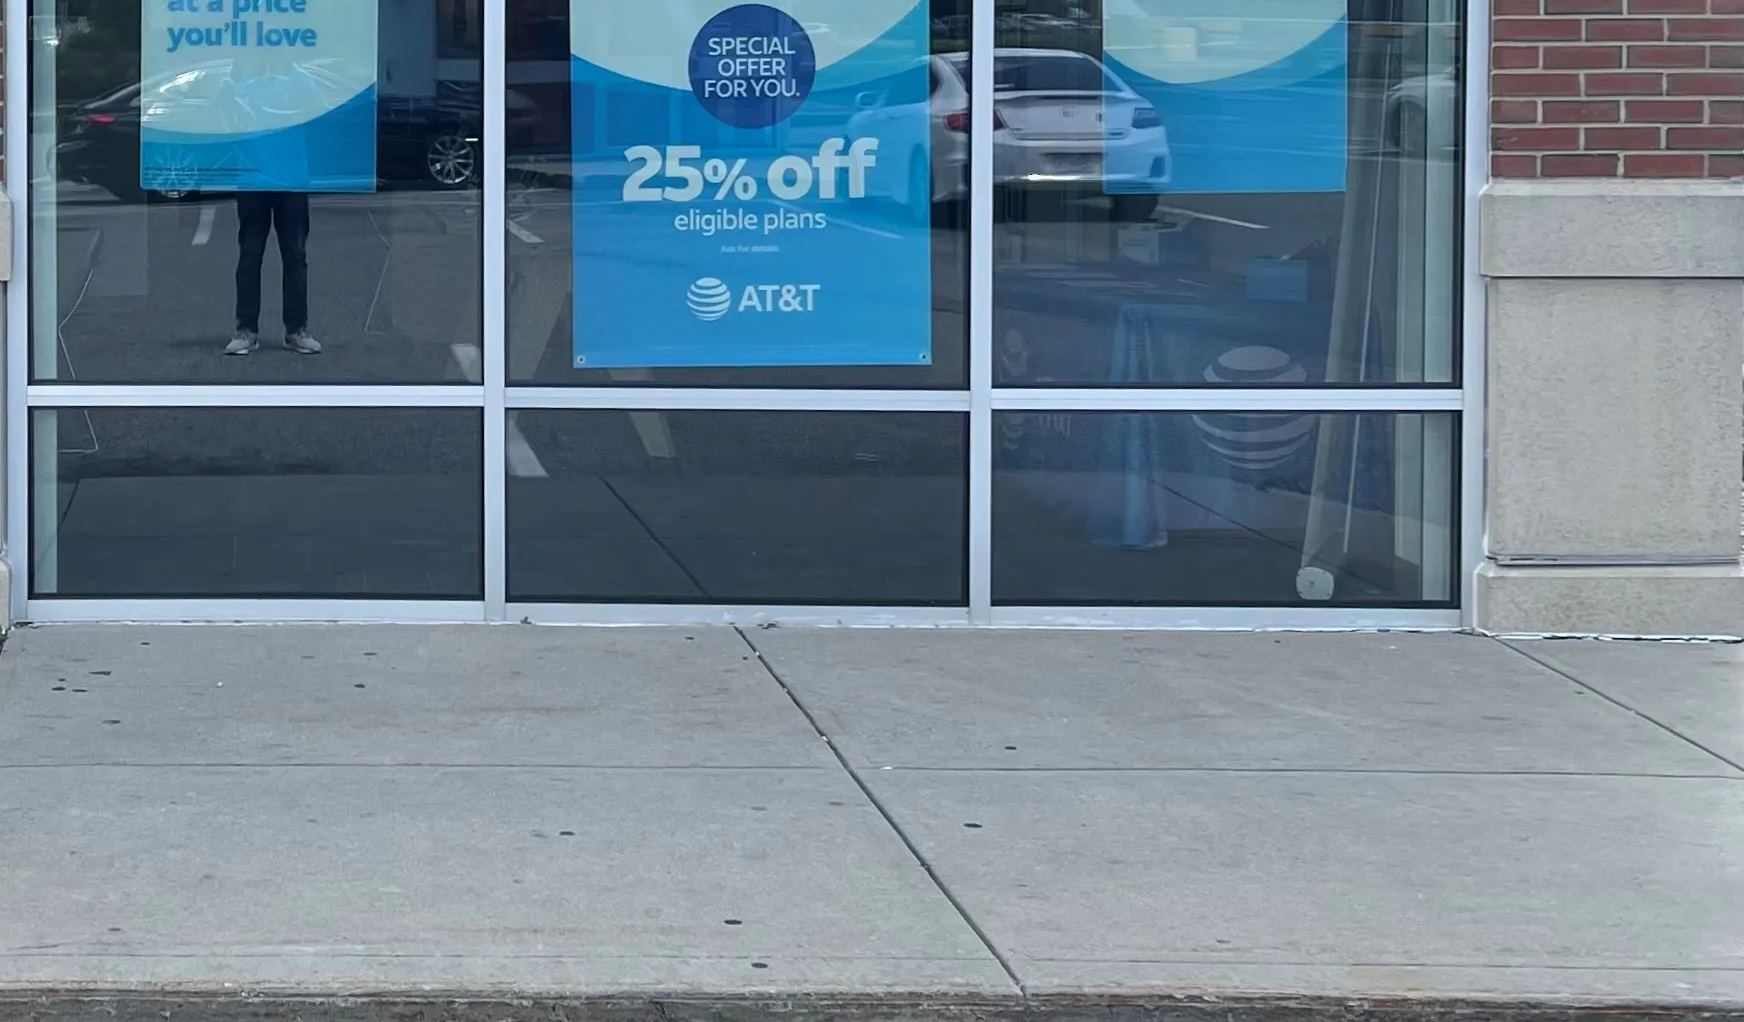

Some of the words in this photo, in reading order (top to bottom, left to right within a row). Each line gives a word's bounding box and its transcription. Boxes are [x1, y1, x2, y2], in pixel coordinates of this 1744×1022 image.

[167, 21, 247, 52] you'll
[257, 21, 317, 47] love
[708, 36, 796, 55] SPECIAL
[717, 58, 786, 77] OFFER
[704, 80, 748, 98] FOR
[750, 78, 801, 98] YOU.
[622, 144, 757, 203] 25%
[767, 137, 880, 200] off
[674, 208, 758, 236] eligible
[764, 208, 827, 235] plans
[738, 284, 821, 312] AT&T
